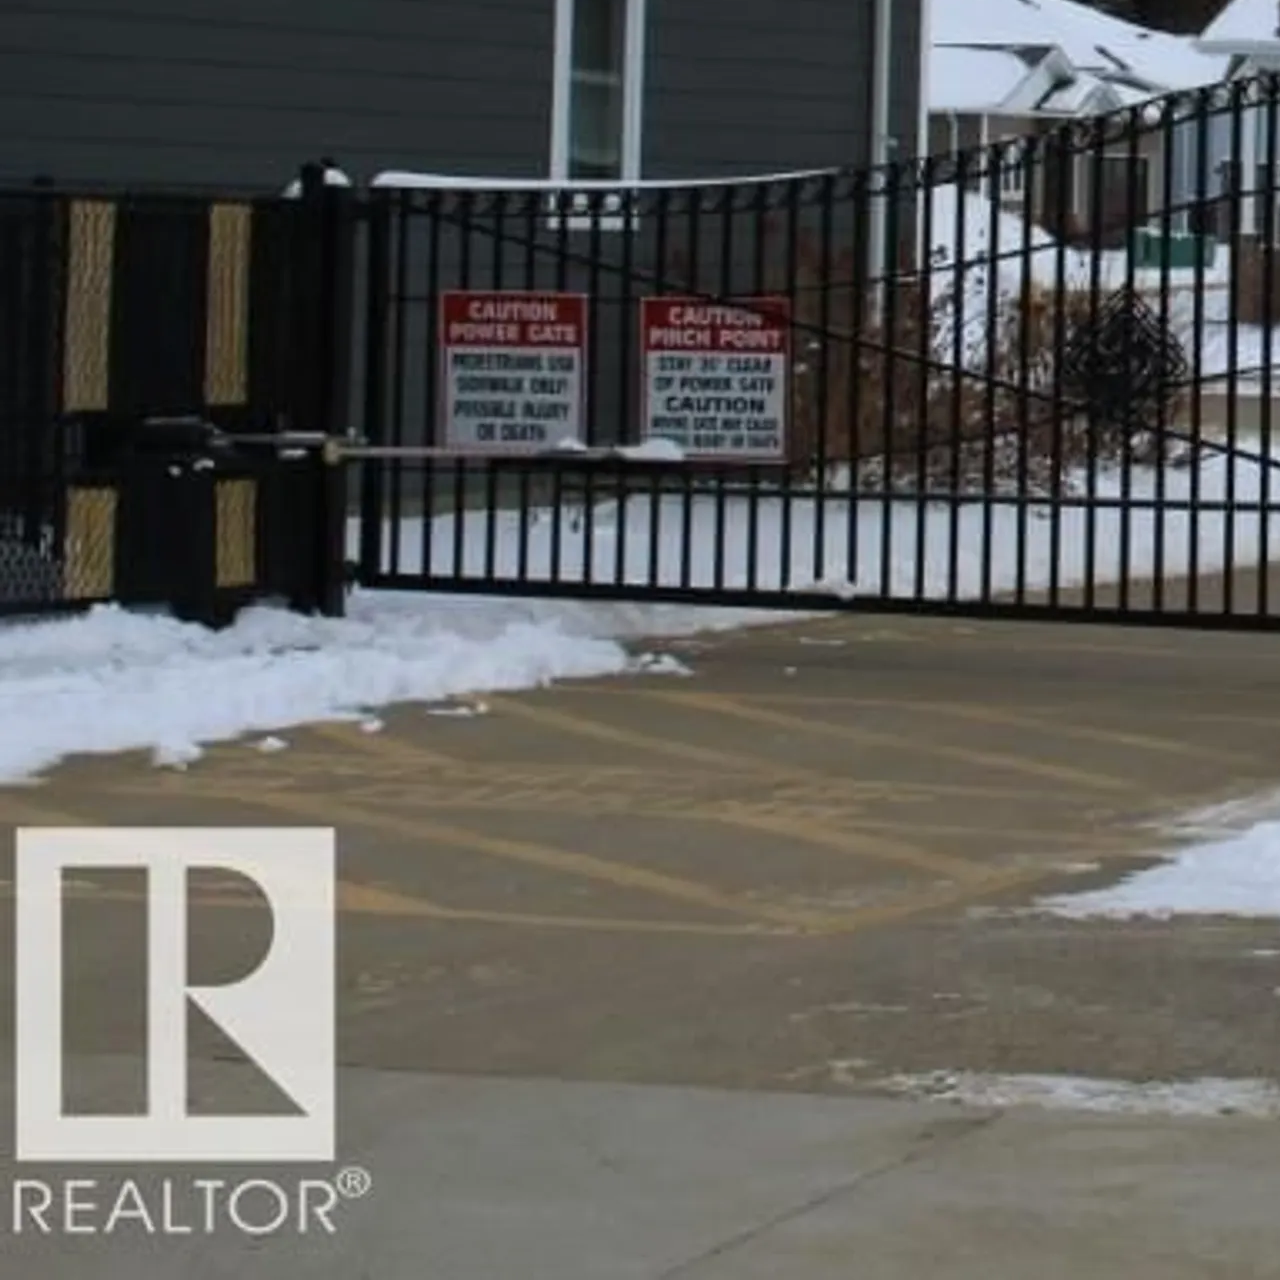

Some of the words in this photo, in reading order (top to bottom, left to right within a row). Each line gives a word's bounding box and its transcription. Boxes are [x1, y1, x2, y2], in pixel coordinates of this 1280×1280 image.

[468, 300, 558, 321] CAUTION
[669, 305, 763, 326] CAUTION
[449, 322, 520, 341] POWER
[527, 323, 578, 343] GATE
[650, 326, 711, 347] PINCH
[720, 329, 780, 348] POINT
[666, 395, 766, 414] CAUTION
